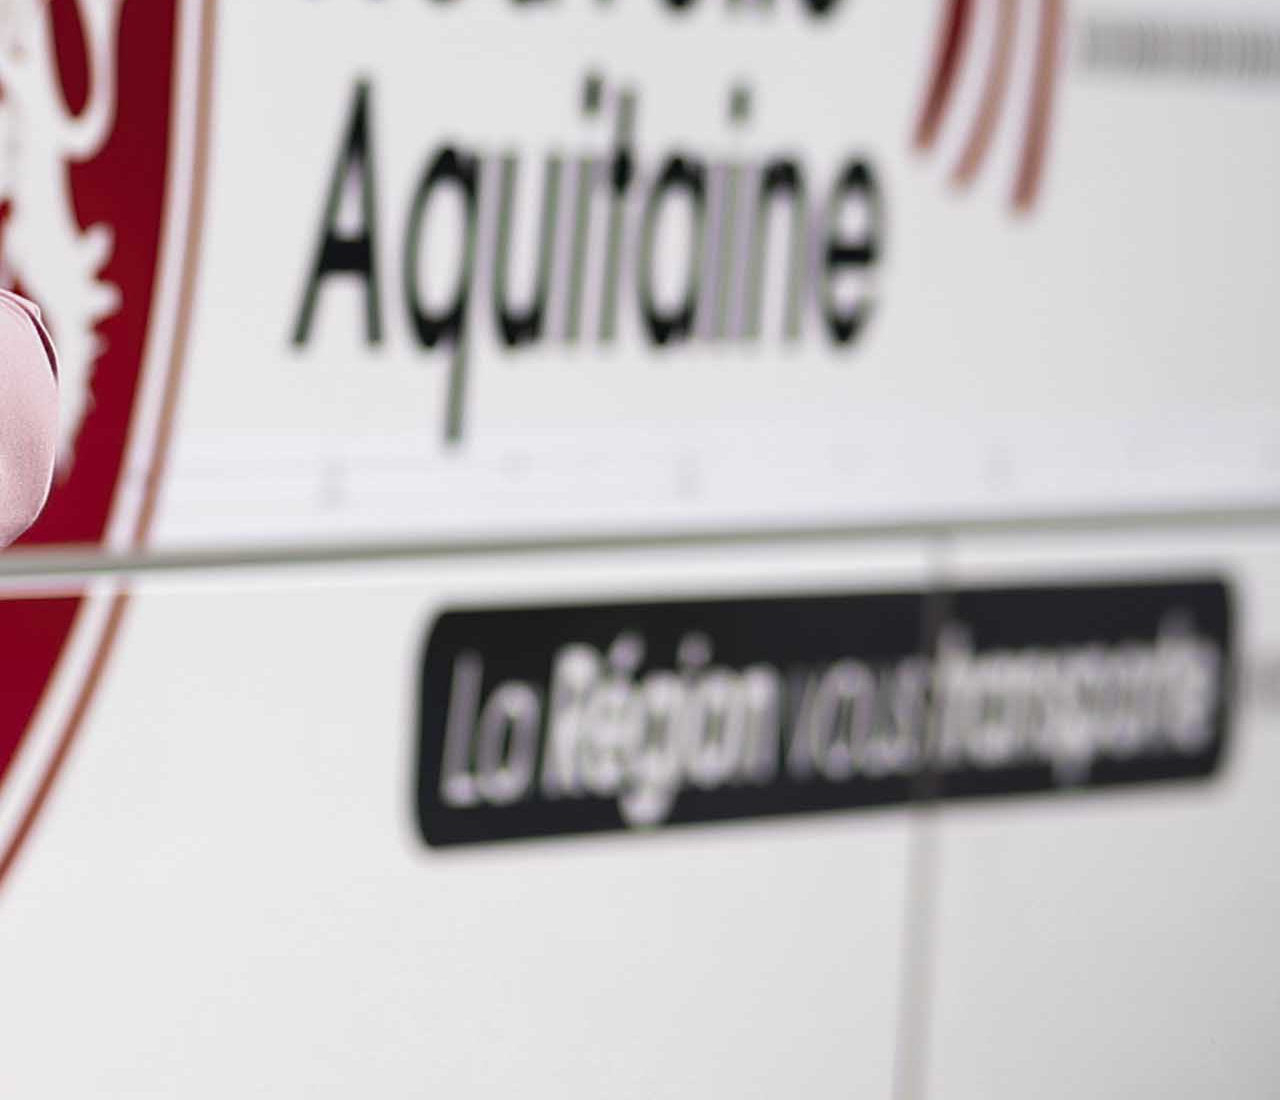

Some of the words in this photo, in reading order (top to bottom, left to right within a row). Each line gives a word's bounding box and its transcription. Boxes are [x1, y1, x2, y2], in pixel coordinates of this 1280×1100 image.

[287, 68, 888, 448] Aquitaine
[439, 647, 539, 808] La
[541, 630, 783, 830] Région
